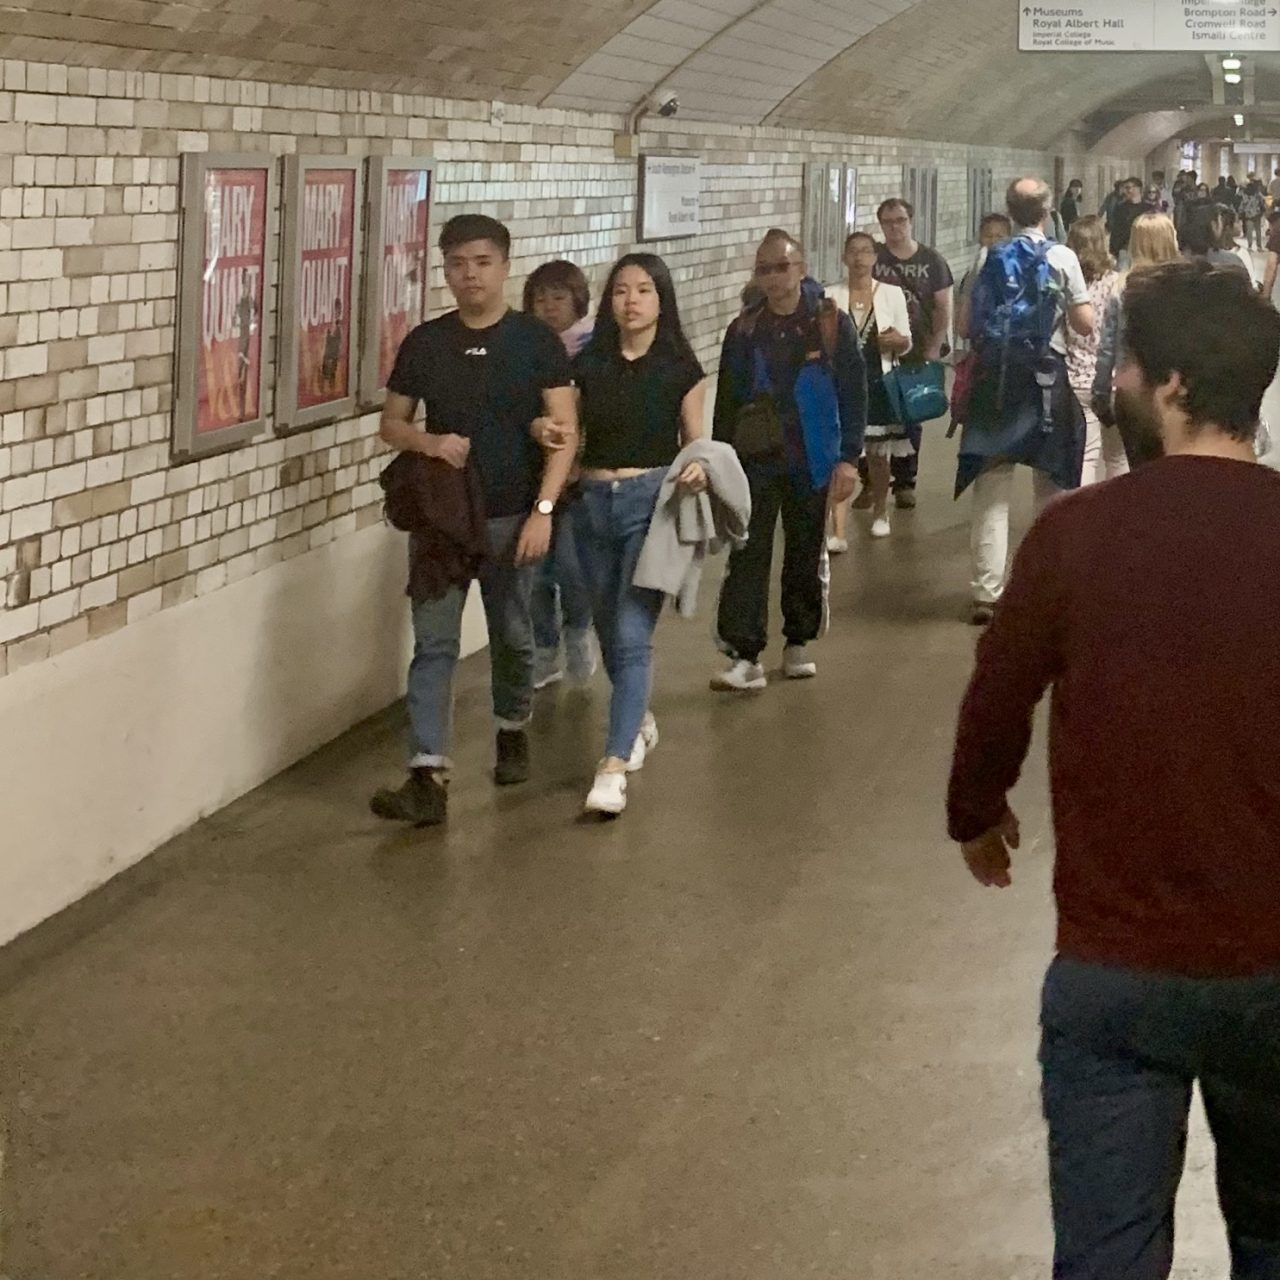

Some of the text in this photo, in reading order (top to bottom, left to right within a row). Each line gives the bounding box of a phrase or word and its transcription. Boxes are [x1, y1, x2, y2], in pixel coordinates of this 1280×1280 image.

[1033, 7, 1083, 17] Museums
[1184, 7, 1266, 18] Brompton Road
[1033, 19, 1124, 29] Royal Albert Hall
[1185, 19, 1266, 28] Cromwell Road
[1033, 31, 1092, 39] Imperial College
[1192, 30, 1266, 40] Ismaili Centre
[303, 183, 344, 251] MARY
[875, 264, 930, 278] WORK
[300, 256, 348, 332] QUANT
